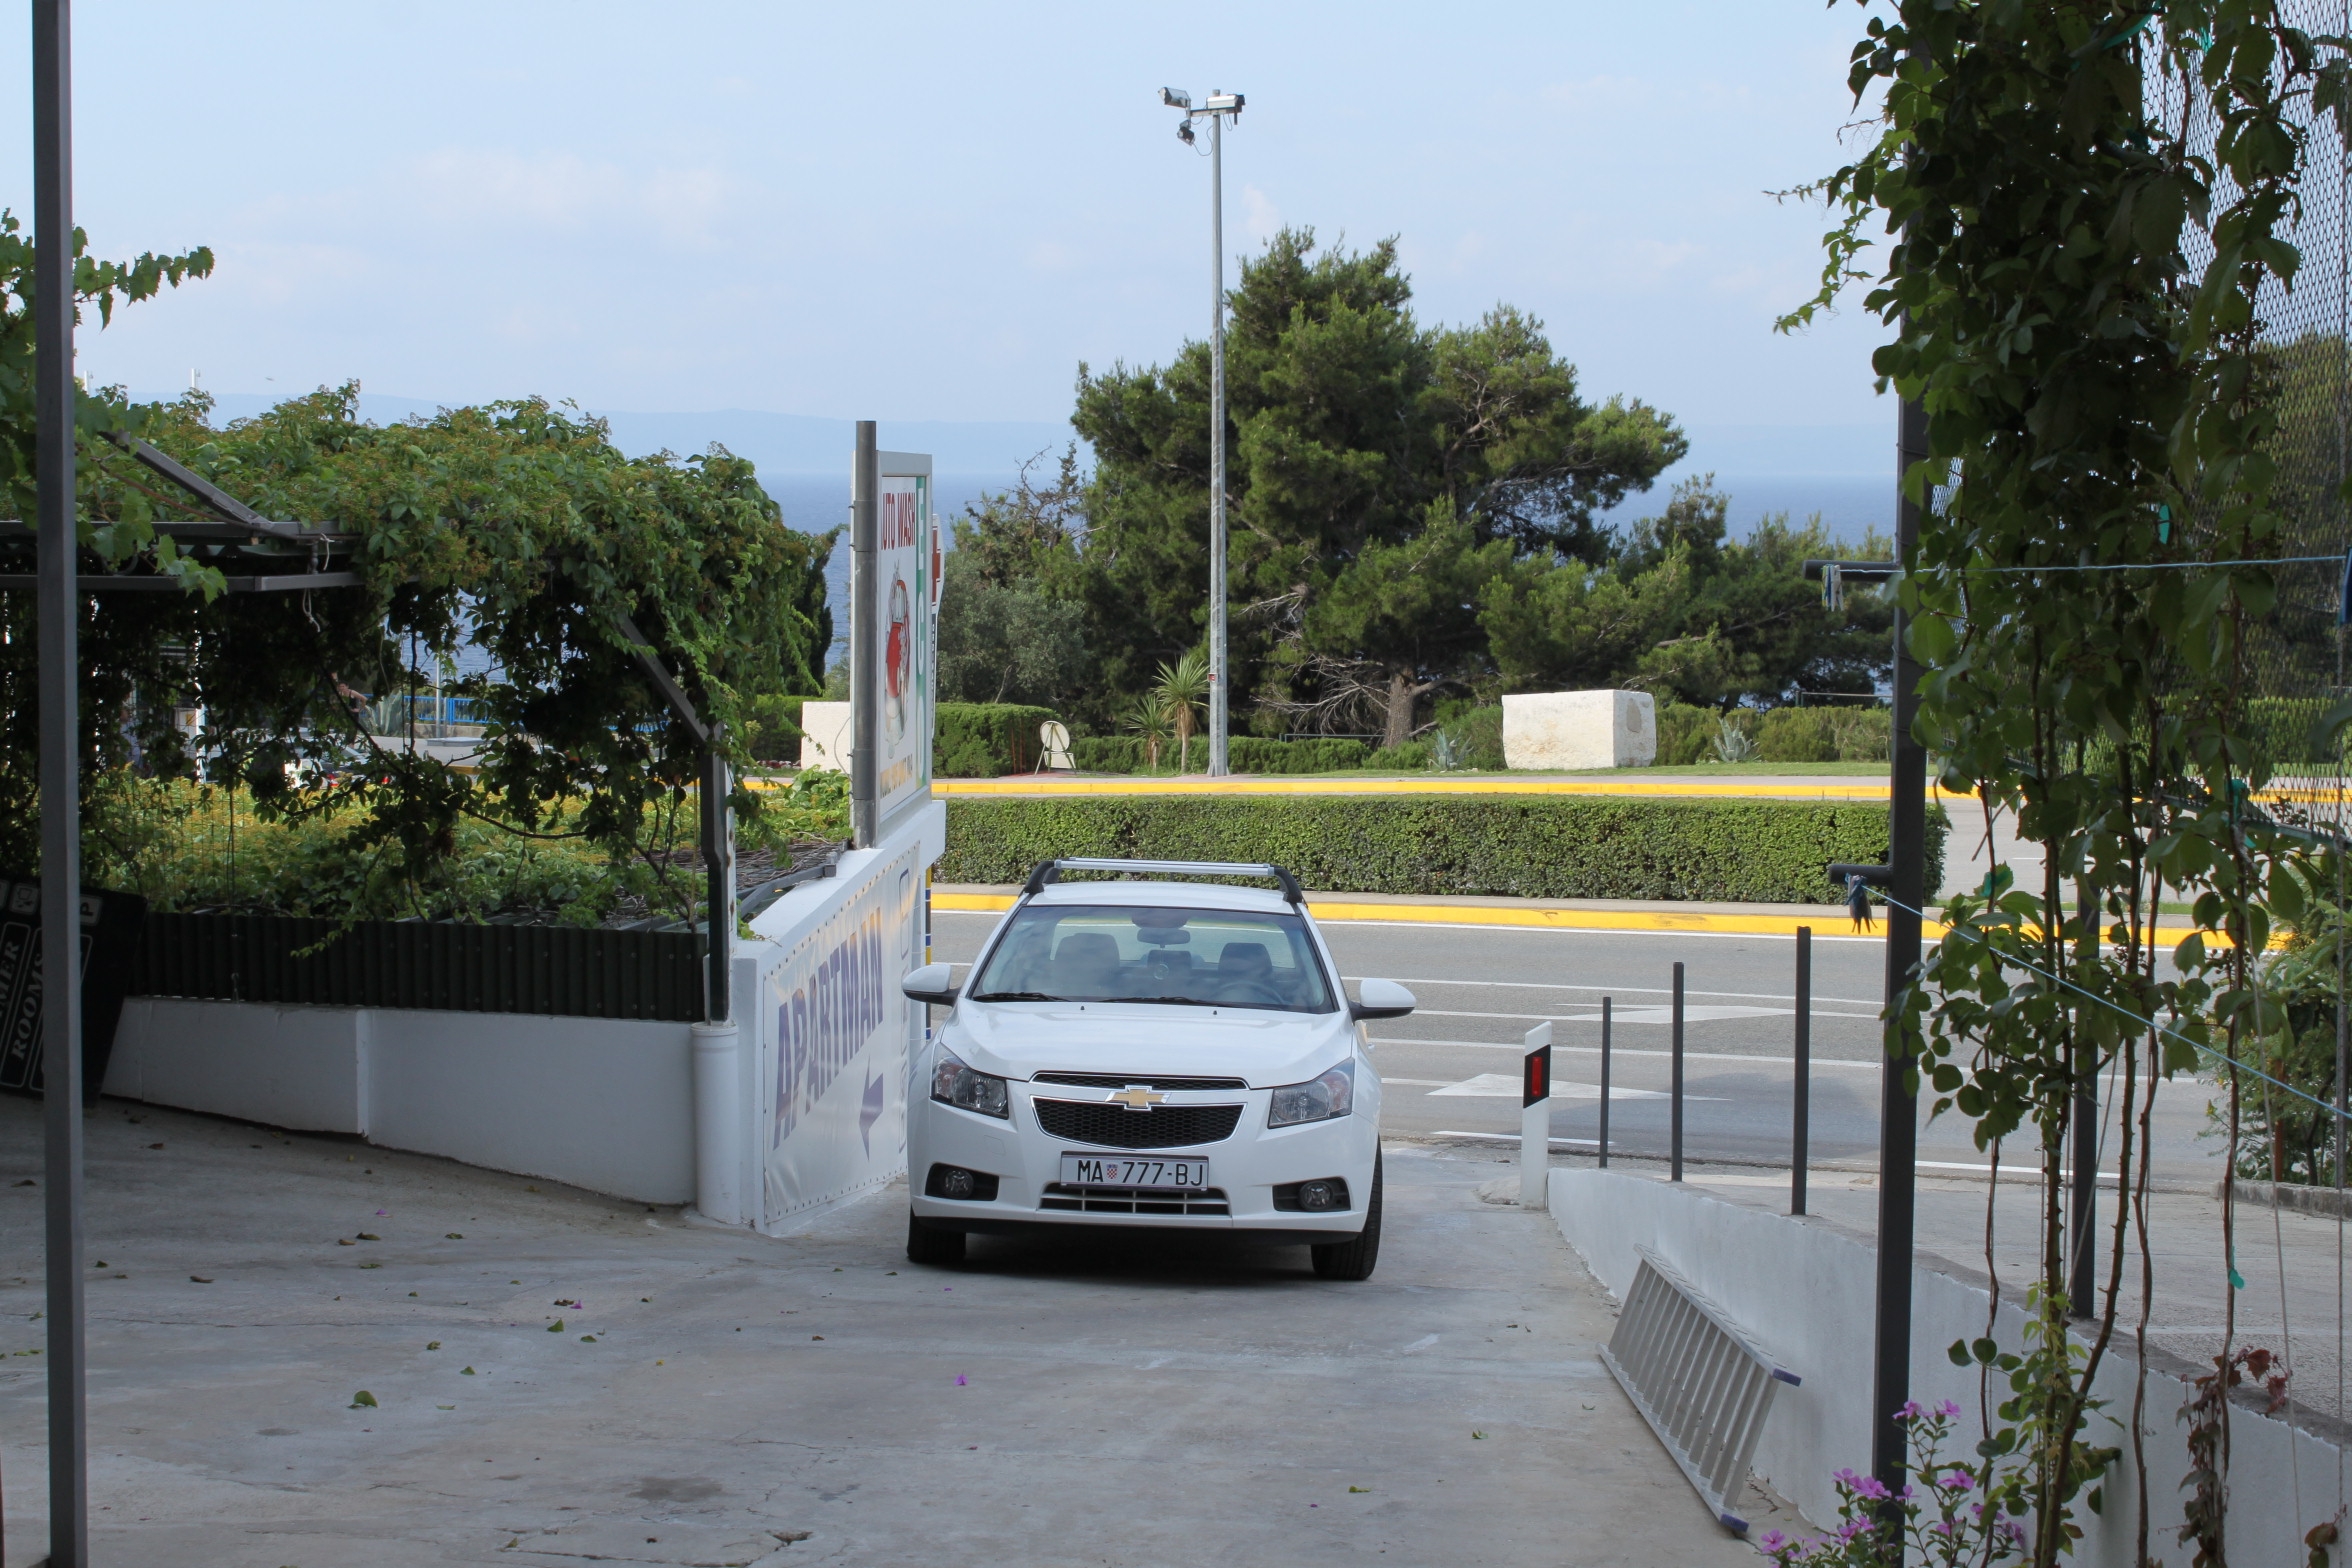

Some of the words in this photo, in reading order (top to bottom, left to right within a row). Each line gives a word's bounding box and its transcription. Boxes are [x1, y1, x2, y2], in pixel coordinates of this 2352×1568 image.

[881, 492, 895, 550] UTO
[897, 492, 916, 548] WASH
[0, 941, 20, 1017] MER
[774, 907, 883, 1151] APARTMAN
[1077, 1160, 1104, 1183] MA
[1122, 1161, 1203, 1186] 777-BJ
